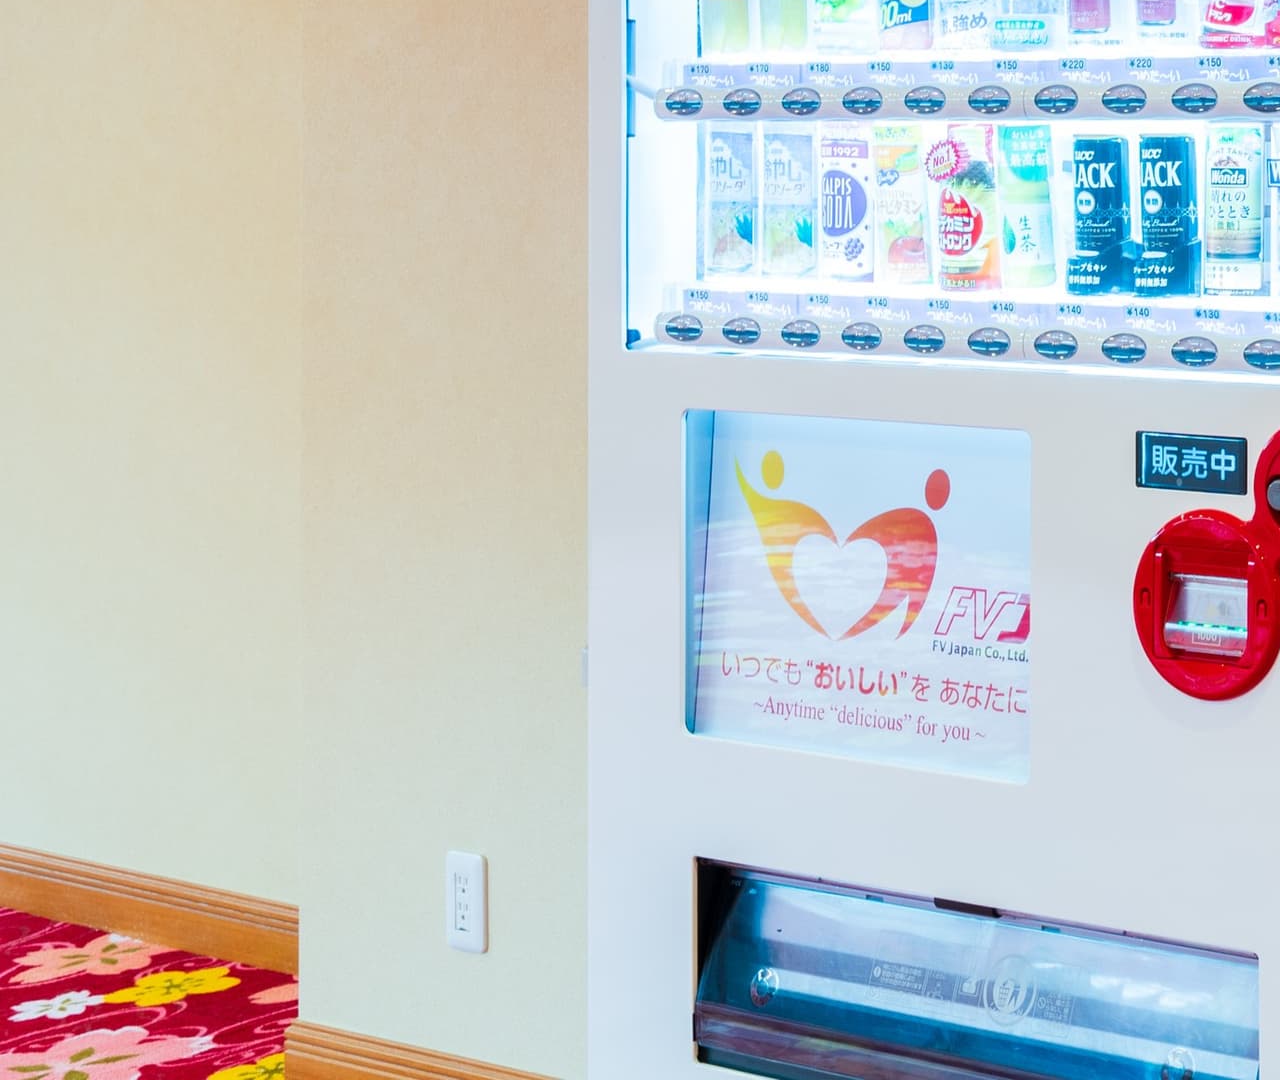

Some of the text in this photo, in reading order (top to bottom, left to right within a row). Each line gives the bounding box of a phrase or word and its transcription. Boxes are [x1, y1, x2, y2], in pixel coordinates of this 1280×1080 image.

[1211, 169, 1246, 185] Wonda
[1151, 444, 1236, 481] 販売中
[932, 640, 1029, 663] FV Japan Co., Ltd.
[940, 677, 1027, 714] あなたに
[916, 717, 937, 736] for
[942, 723, 971, 742] you
